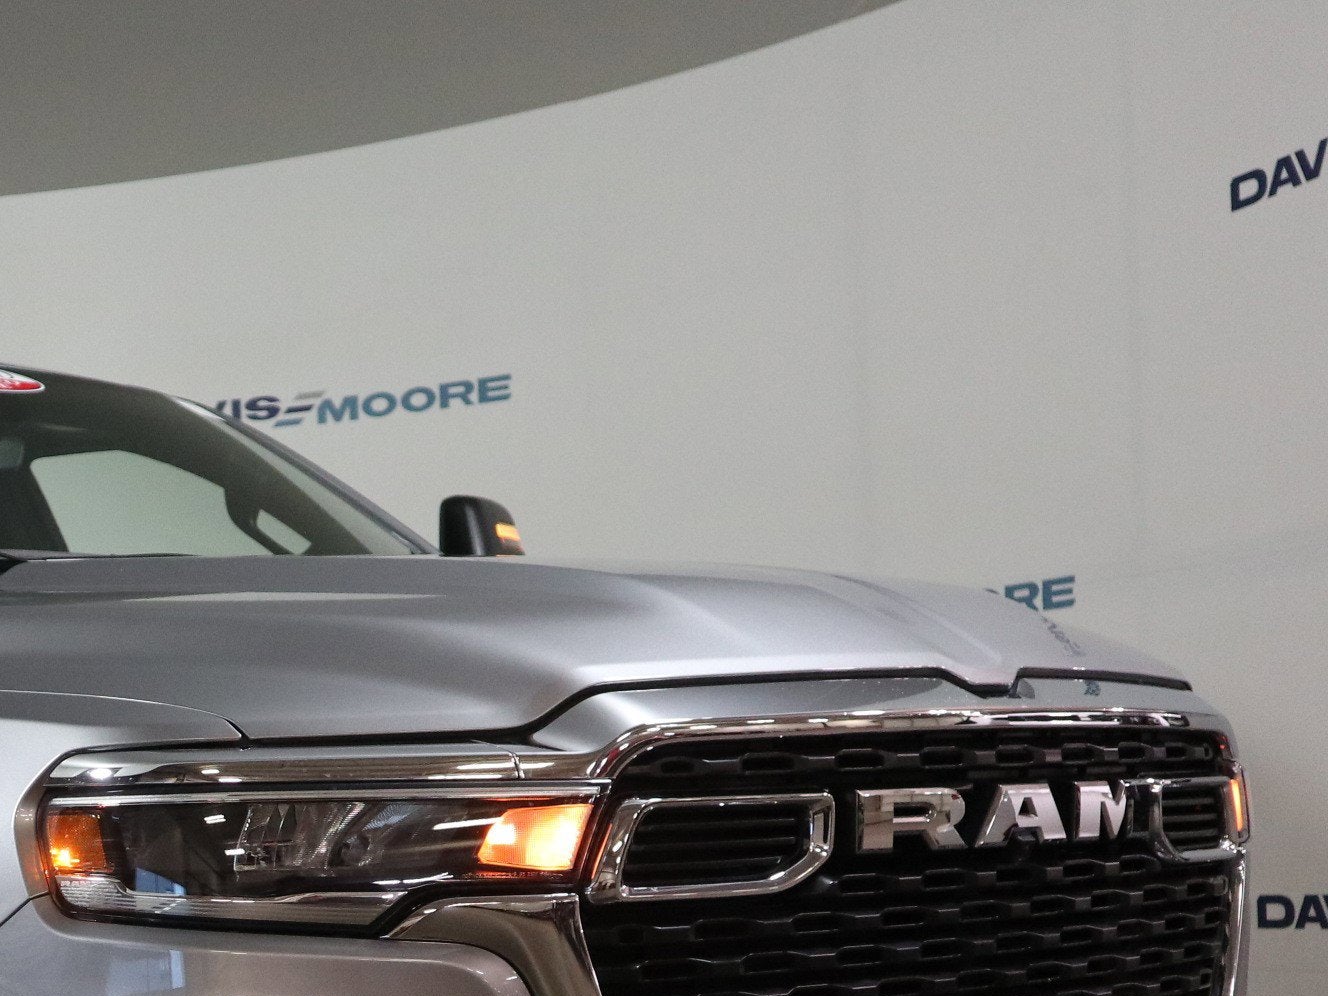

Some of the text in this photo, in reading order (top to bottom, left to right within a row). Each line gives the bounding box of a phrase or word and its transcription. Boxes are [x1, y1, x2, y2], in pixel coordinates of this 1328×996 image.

[1230, 138, 1328, 212] DAV
[317, 374, 512, 424] MOORE
[855, 780, 1128, 854] RAM
[1256, 894, 1328, 929] DA
